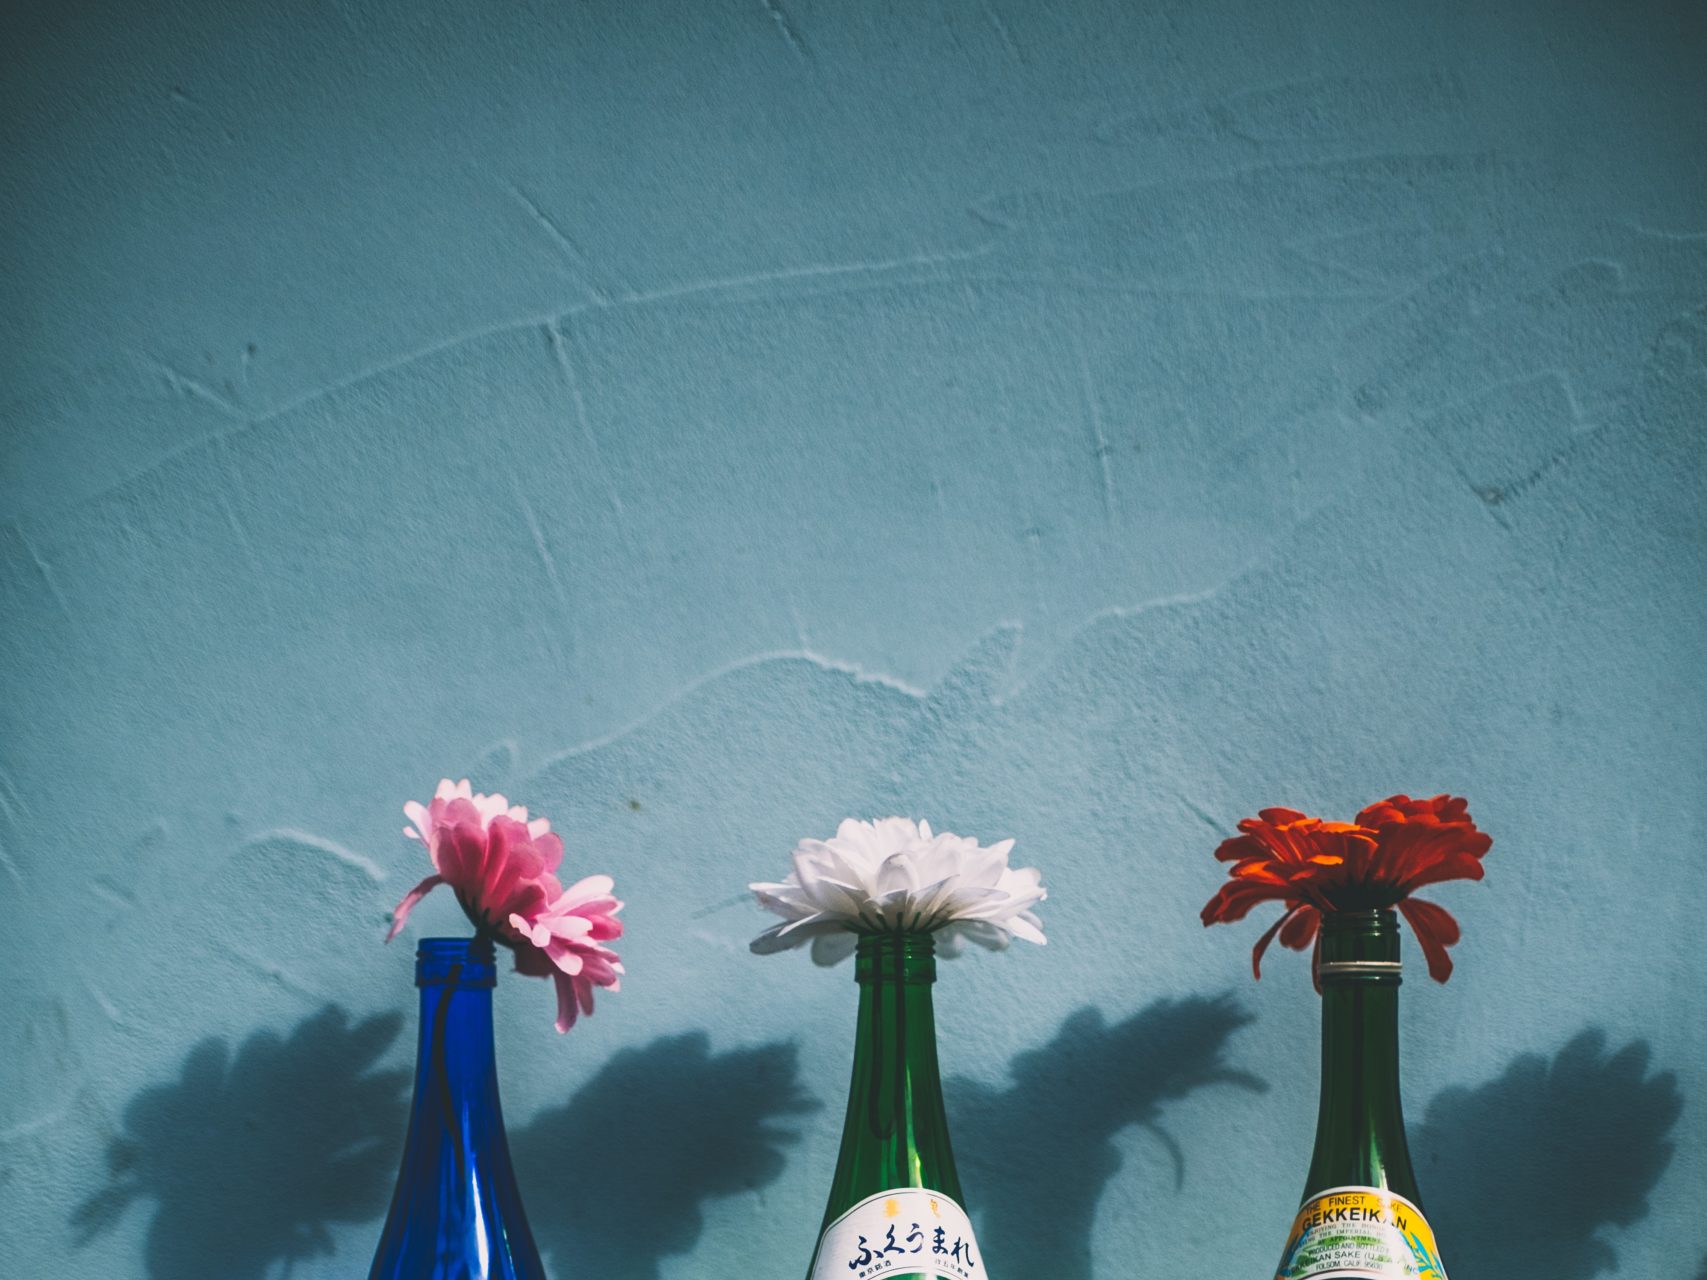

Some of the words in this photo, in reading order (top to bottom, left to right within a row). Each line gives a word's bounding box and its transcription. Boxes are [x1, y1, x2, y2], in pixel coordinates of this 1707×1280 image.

[1306, 1201, 1321, 1216] THE
[1328, 1195, 1365, 1208] FINEST
[1377, 1198, 1402, 1213] SKE
[848, 1222, 975, 1271] ふくうまれ
[1334, 1250, 1361, 1259] SAKE
[1315, 1260, 1341, 1271] FOLSOM
